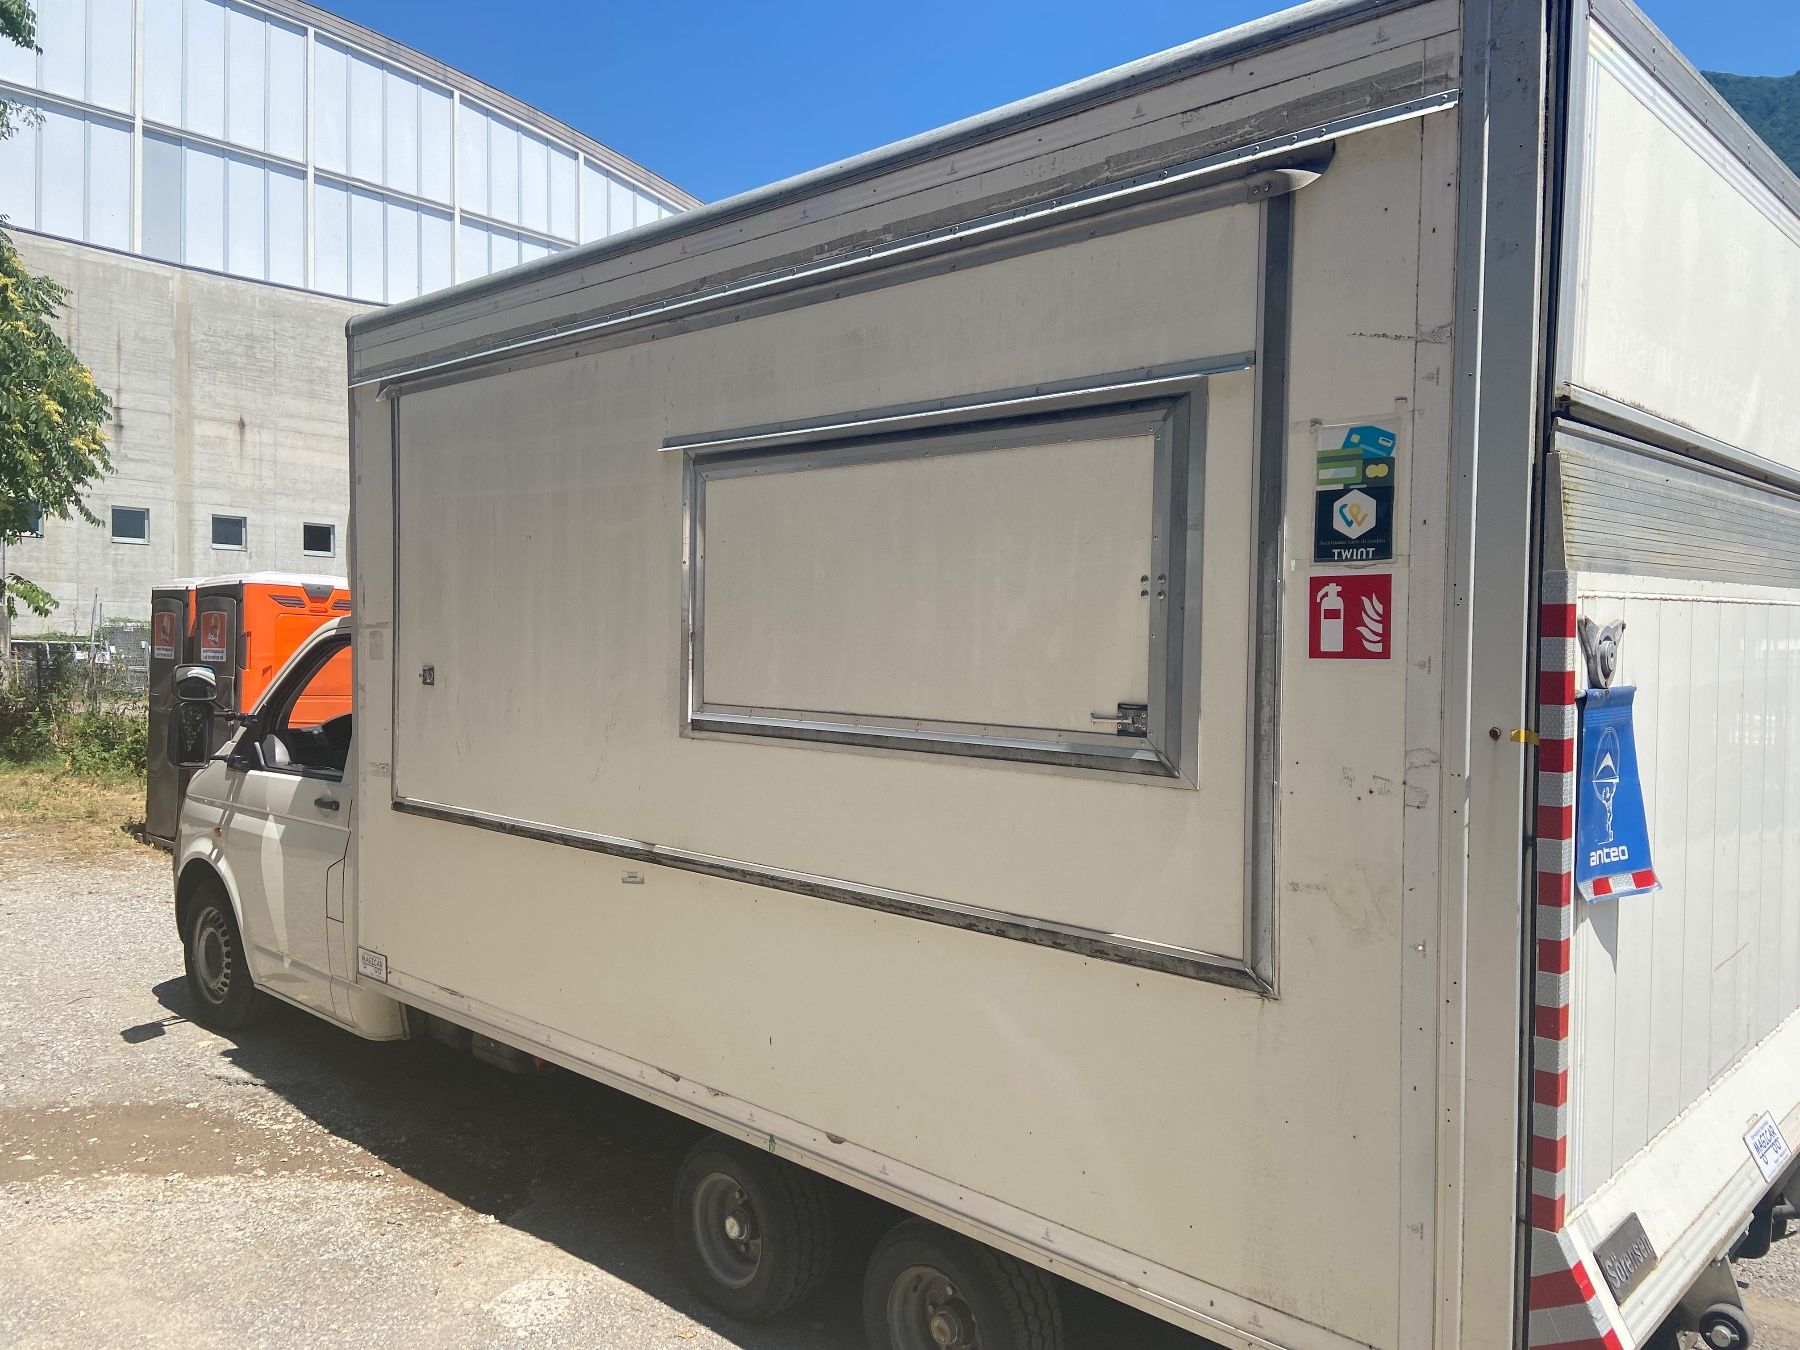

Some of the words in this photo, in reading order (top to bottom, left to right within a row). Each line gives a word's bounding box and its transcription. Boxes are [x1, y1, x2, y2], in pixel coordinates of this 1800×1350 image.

[1332, 547, 1376, 560] TWINT
[1589, 845, 1629, 867] anteo
[1752, 1124, 1777, 1156] MAGICAR
[1604, 1235, 1655, 1289] Sörensen
